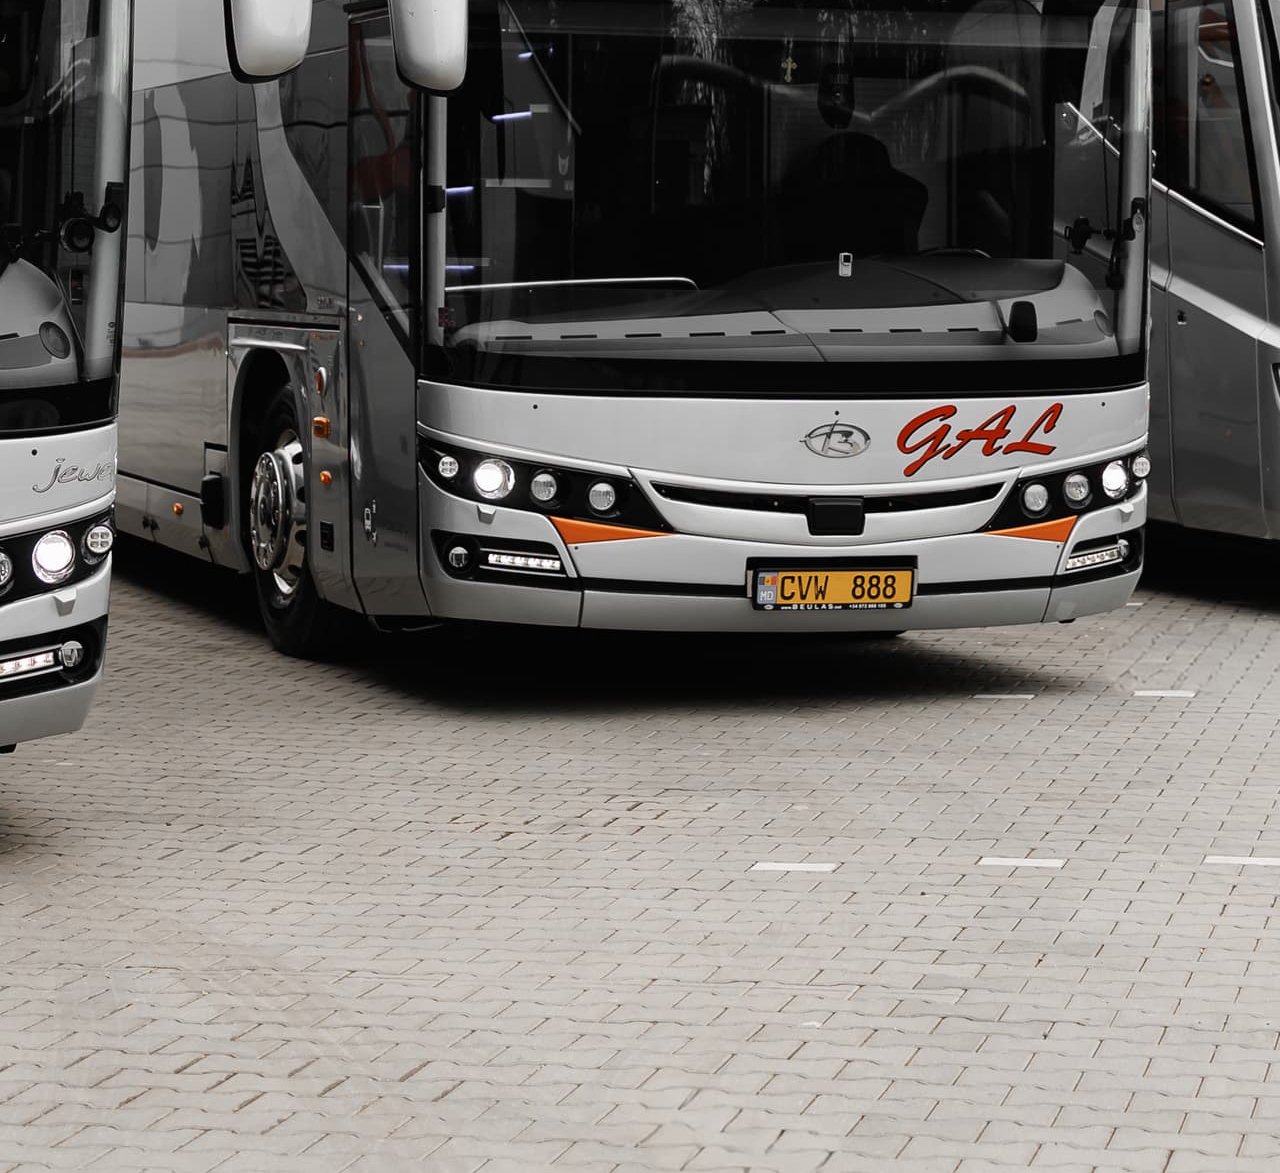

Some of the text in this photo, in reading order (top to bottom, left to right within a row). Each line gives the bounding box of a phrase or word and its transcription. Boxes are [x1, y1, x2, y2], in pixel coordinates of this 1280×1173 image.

[896, 402, 1064, 477] GAL
[780, 574, 896, 601] CVW 888
